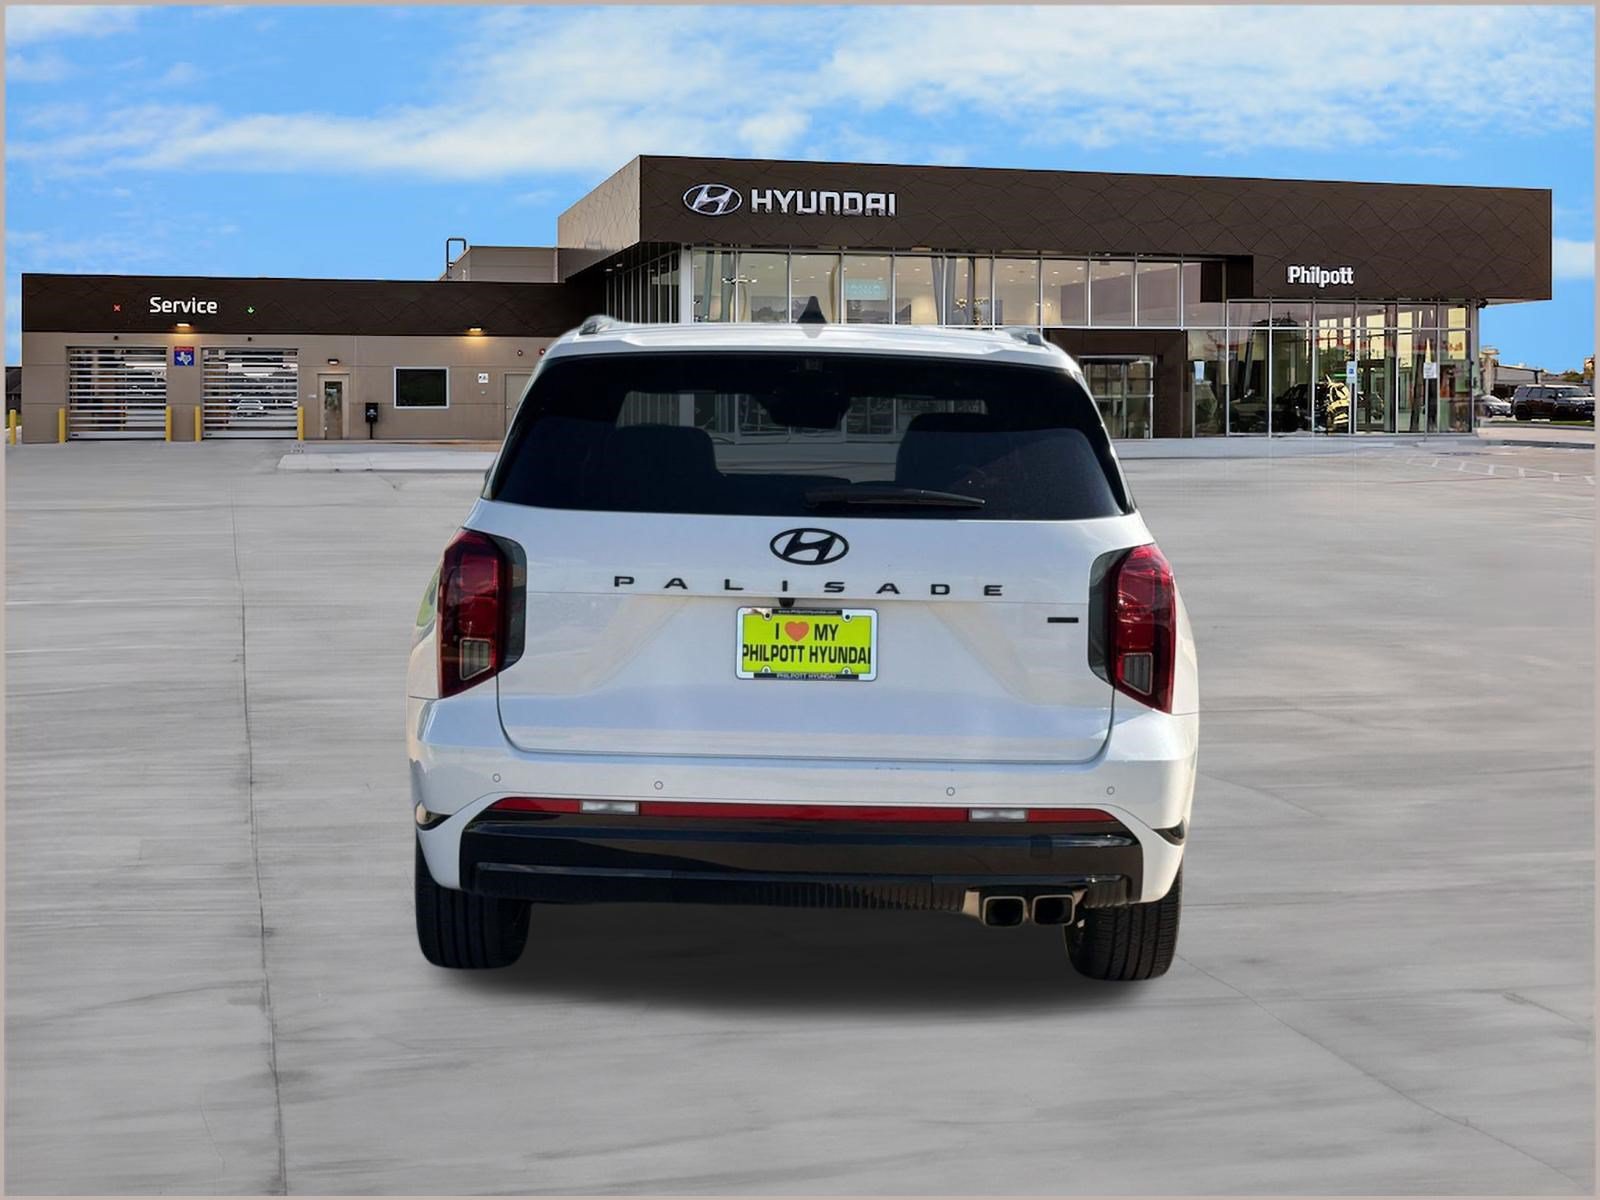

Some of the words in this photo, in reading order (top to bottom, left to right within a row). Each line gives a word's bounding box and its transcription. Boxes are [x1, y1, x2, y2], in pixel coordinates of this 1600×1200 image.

[751, 189, 896, 216] HYUNDAI
[1287, 265, 1354, 288] Philpott
[149, 296, 218, 314] Service
[613, 576, 1005, 597] PALISADE
[775, 622, 780, 640] I
[814, 623, 839, 641] MY
[743, 643, 805, 662] PHILPOTT
[809, 645, 871, 664] HYUNDAI
